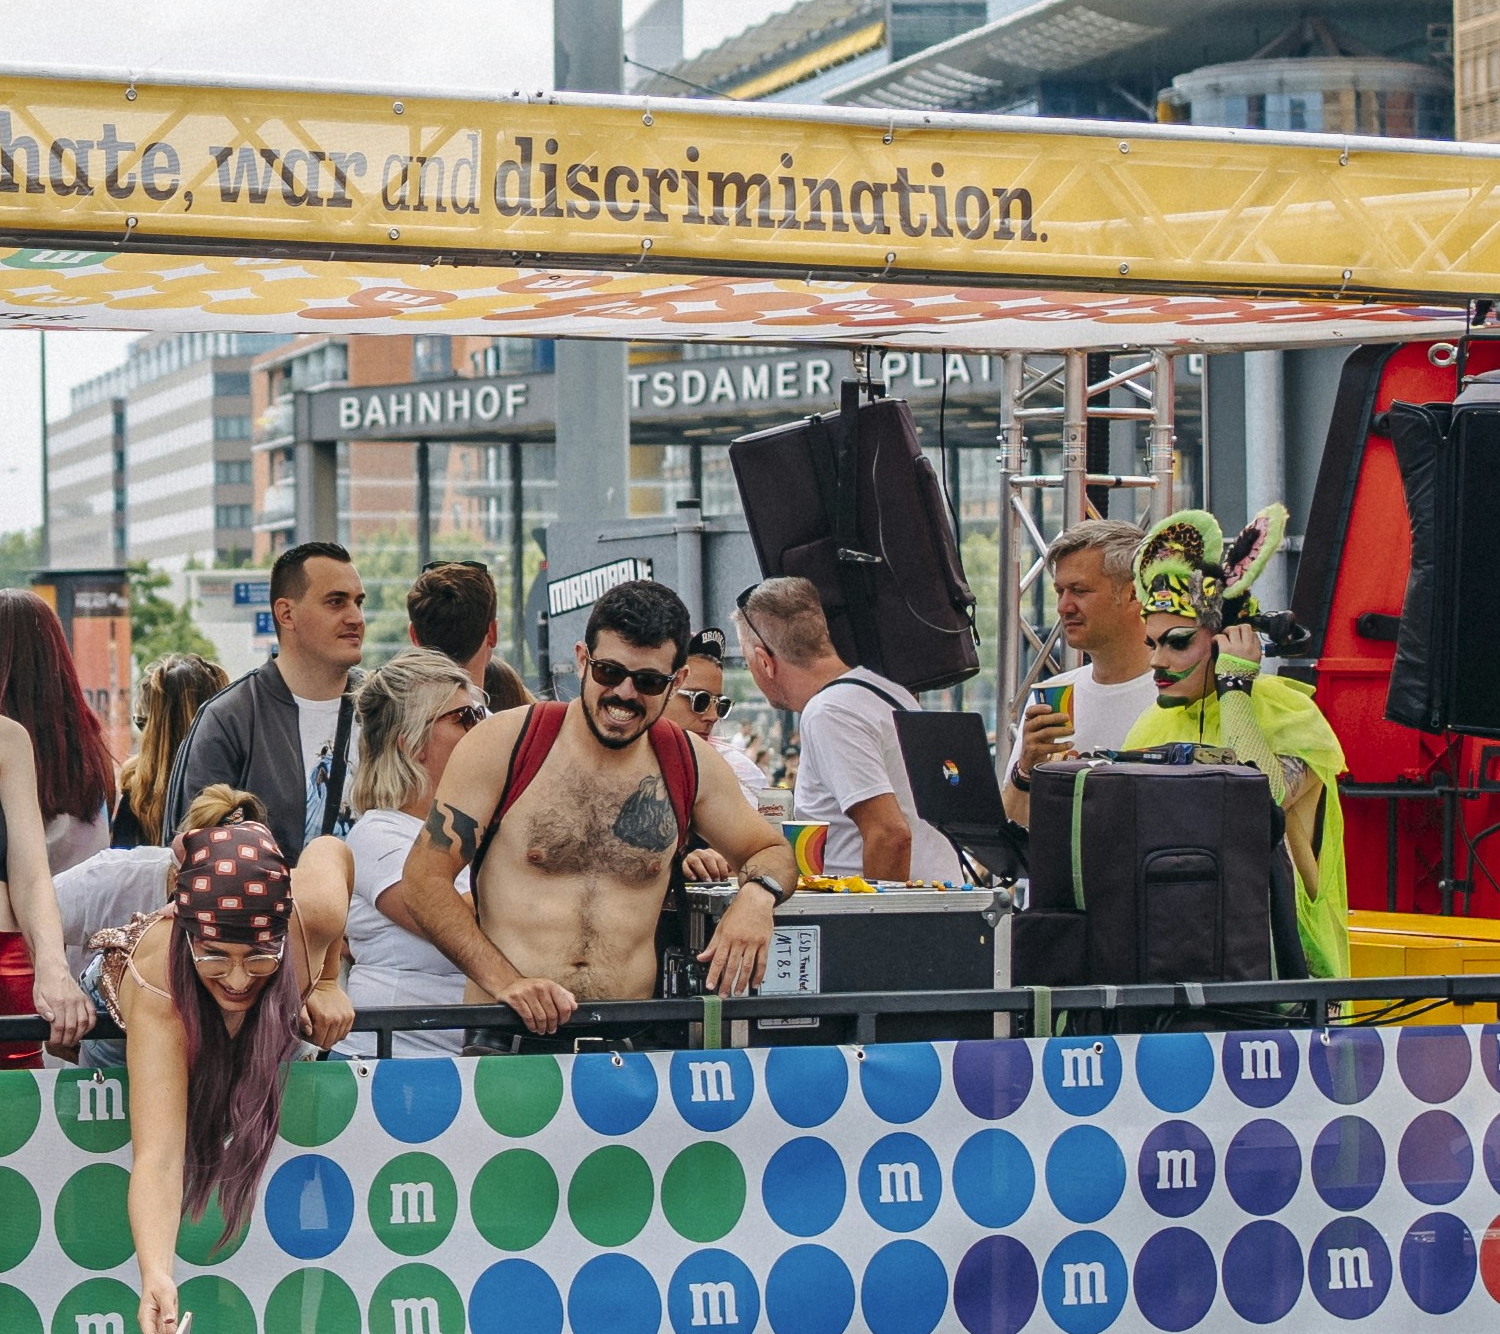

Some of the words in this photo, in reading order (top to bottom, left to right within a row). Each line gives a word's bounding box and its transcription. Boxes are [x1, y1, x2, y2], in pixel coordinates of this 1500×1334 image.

[215, 140, 368, 208] war
[382, 131, 481, 216] and
[494, 134, 1050, 243] discrimination.
[339, 384, 529, 430] BAHNHOF
[627, 359, 833, 408] TSDAMER
[77, 1076, 125, 1121] m
[689, 1061, 735, 1101] m
[1061, 1047, 1103, 1087] m
[1240, 1040, 1281, 1079] m
[390, 1182, 436, 1223] m
[878, 1163, 923, 1202] m
[1157, 1150, 1196, 1189] m
[689, 1282, 738, 1325] m
[1063, 1262, 1107, 1305] m
[1328, 1247, 1373, 1289] m
